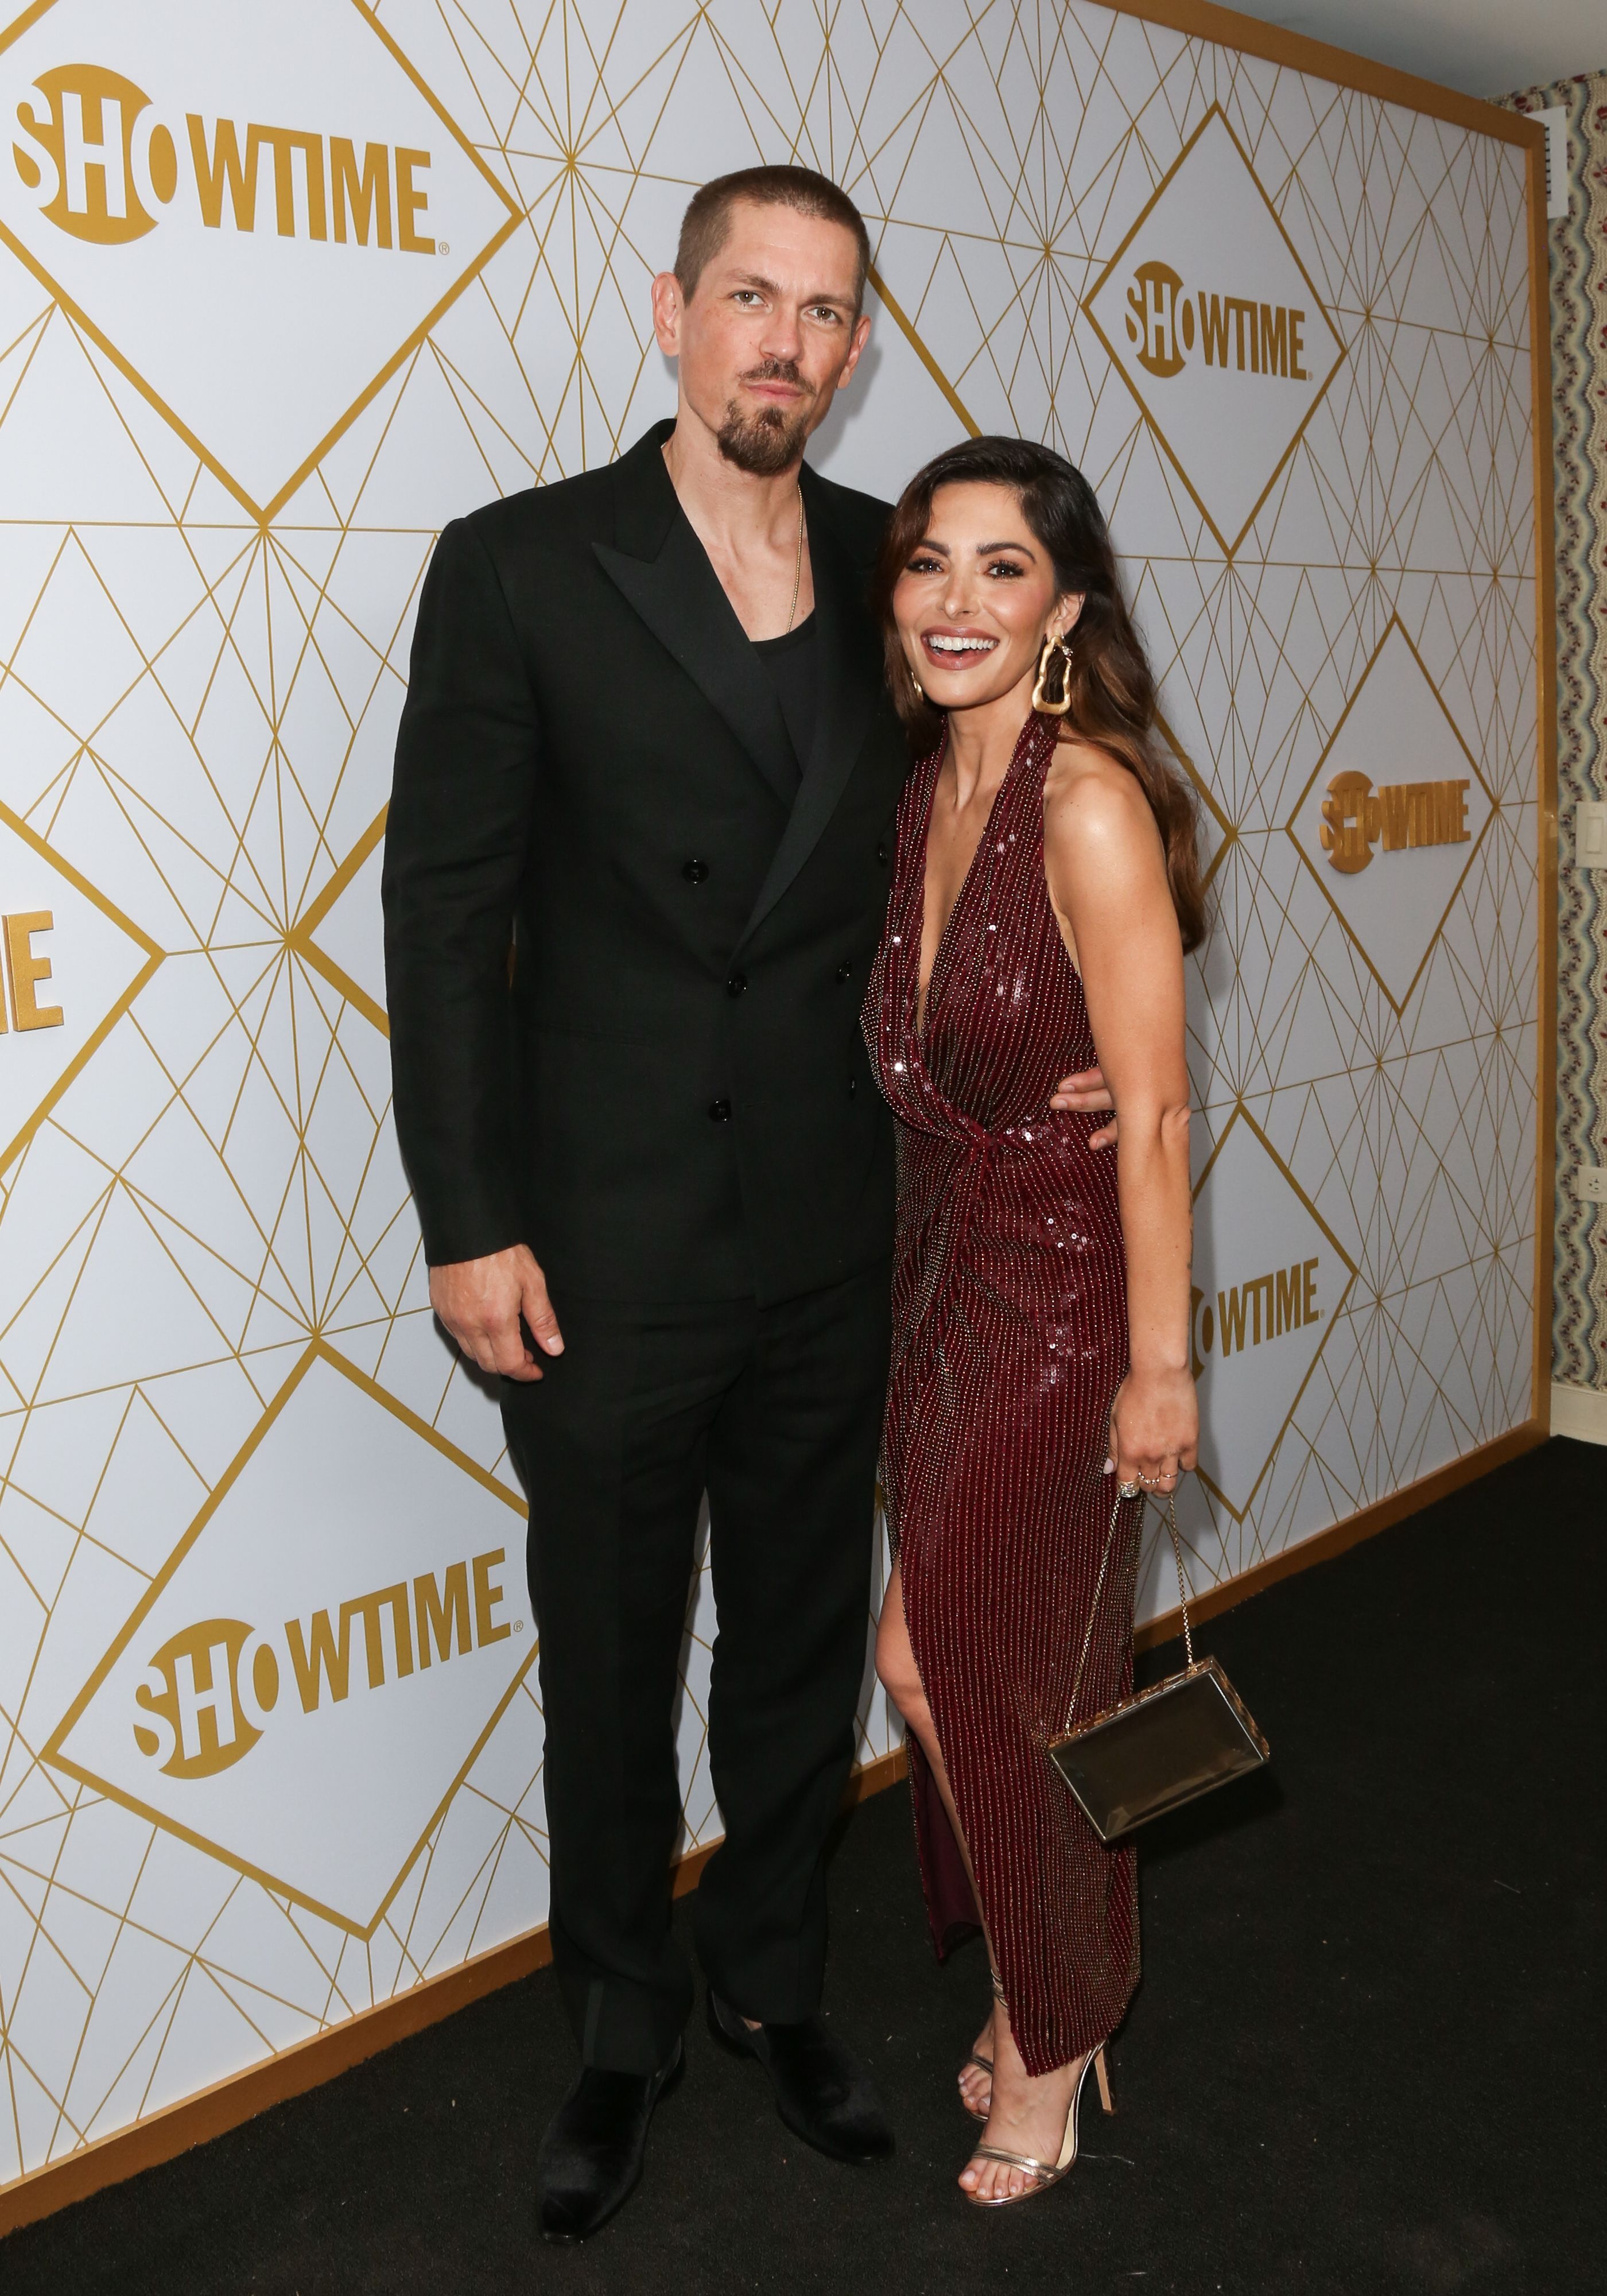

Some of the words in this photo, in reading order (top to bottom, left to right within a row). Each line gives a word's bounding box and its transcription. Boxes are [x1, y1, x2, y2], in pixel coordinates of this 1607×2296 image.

[1319, 770, 1471, 874] SHOWTIME
[0, 910, 64, 1033] E
[1192, 1257, 1319, 1380] OWTIME
